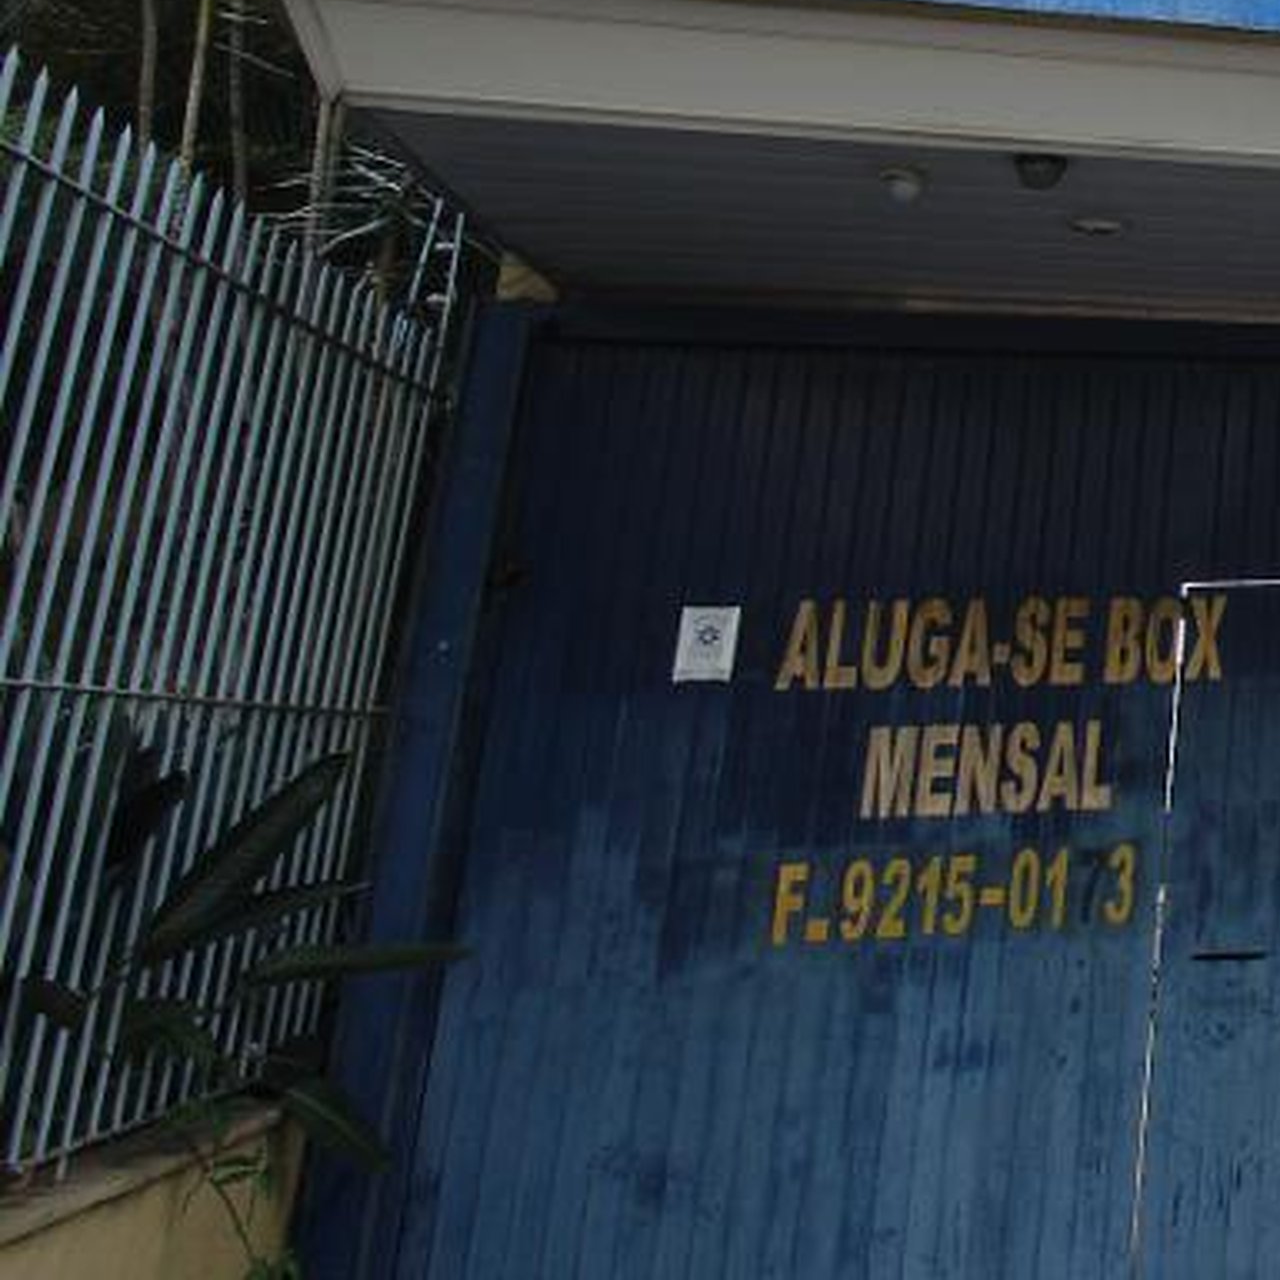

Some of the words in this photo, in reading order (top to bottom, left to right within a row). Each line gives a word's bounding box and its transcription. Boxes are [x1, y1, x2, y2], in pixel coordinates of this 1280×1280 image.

[774, 594, 1089, 691] ALUGA-SE
[1103, 593, 1227, 685] BOX
[859, 719, 1114, 819] MENSAL
